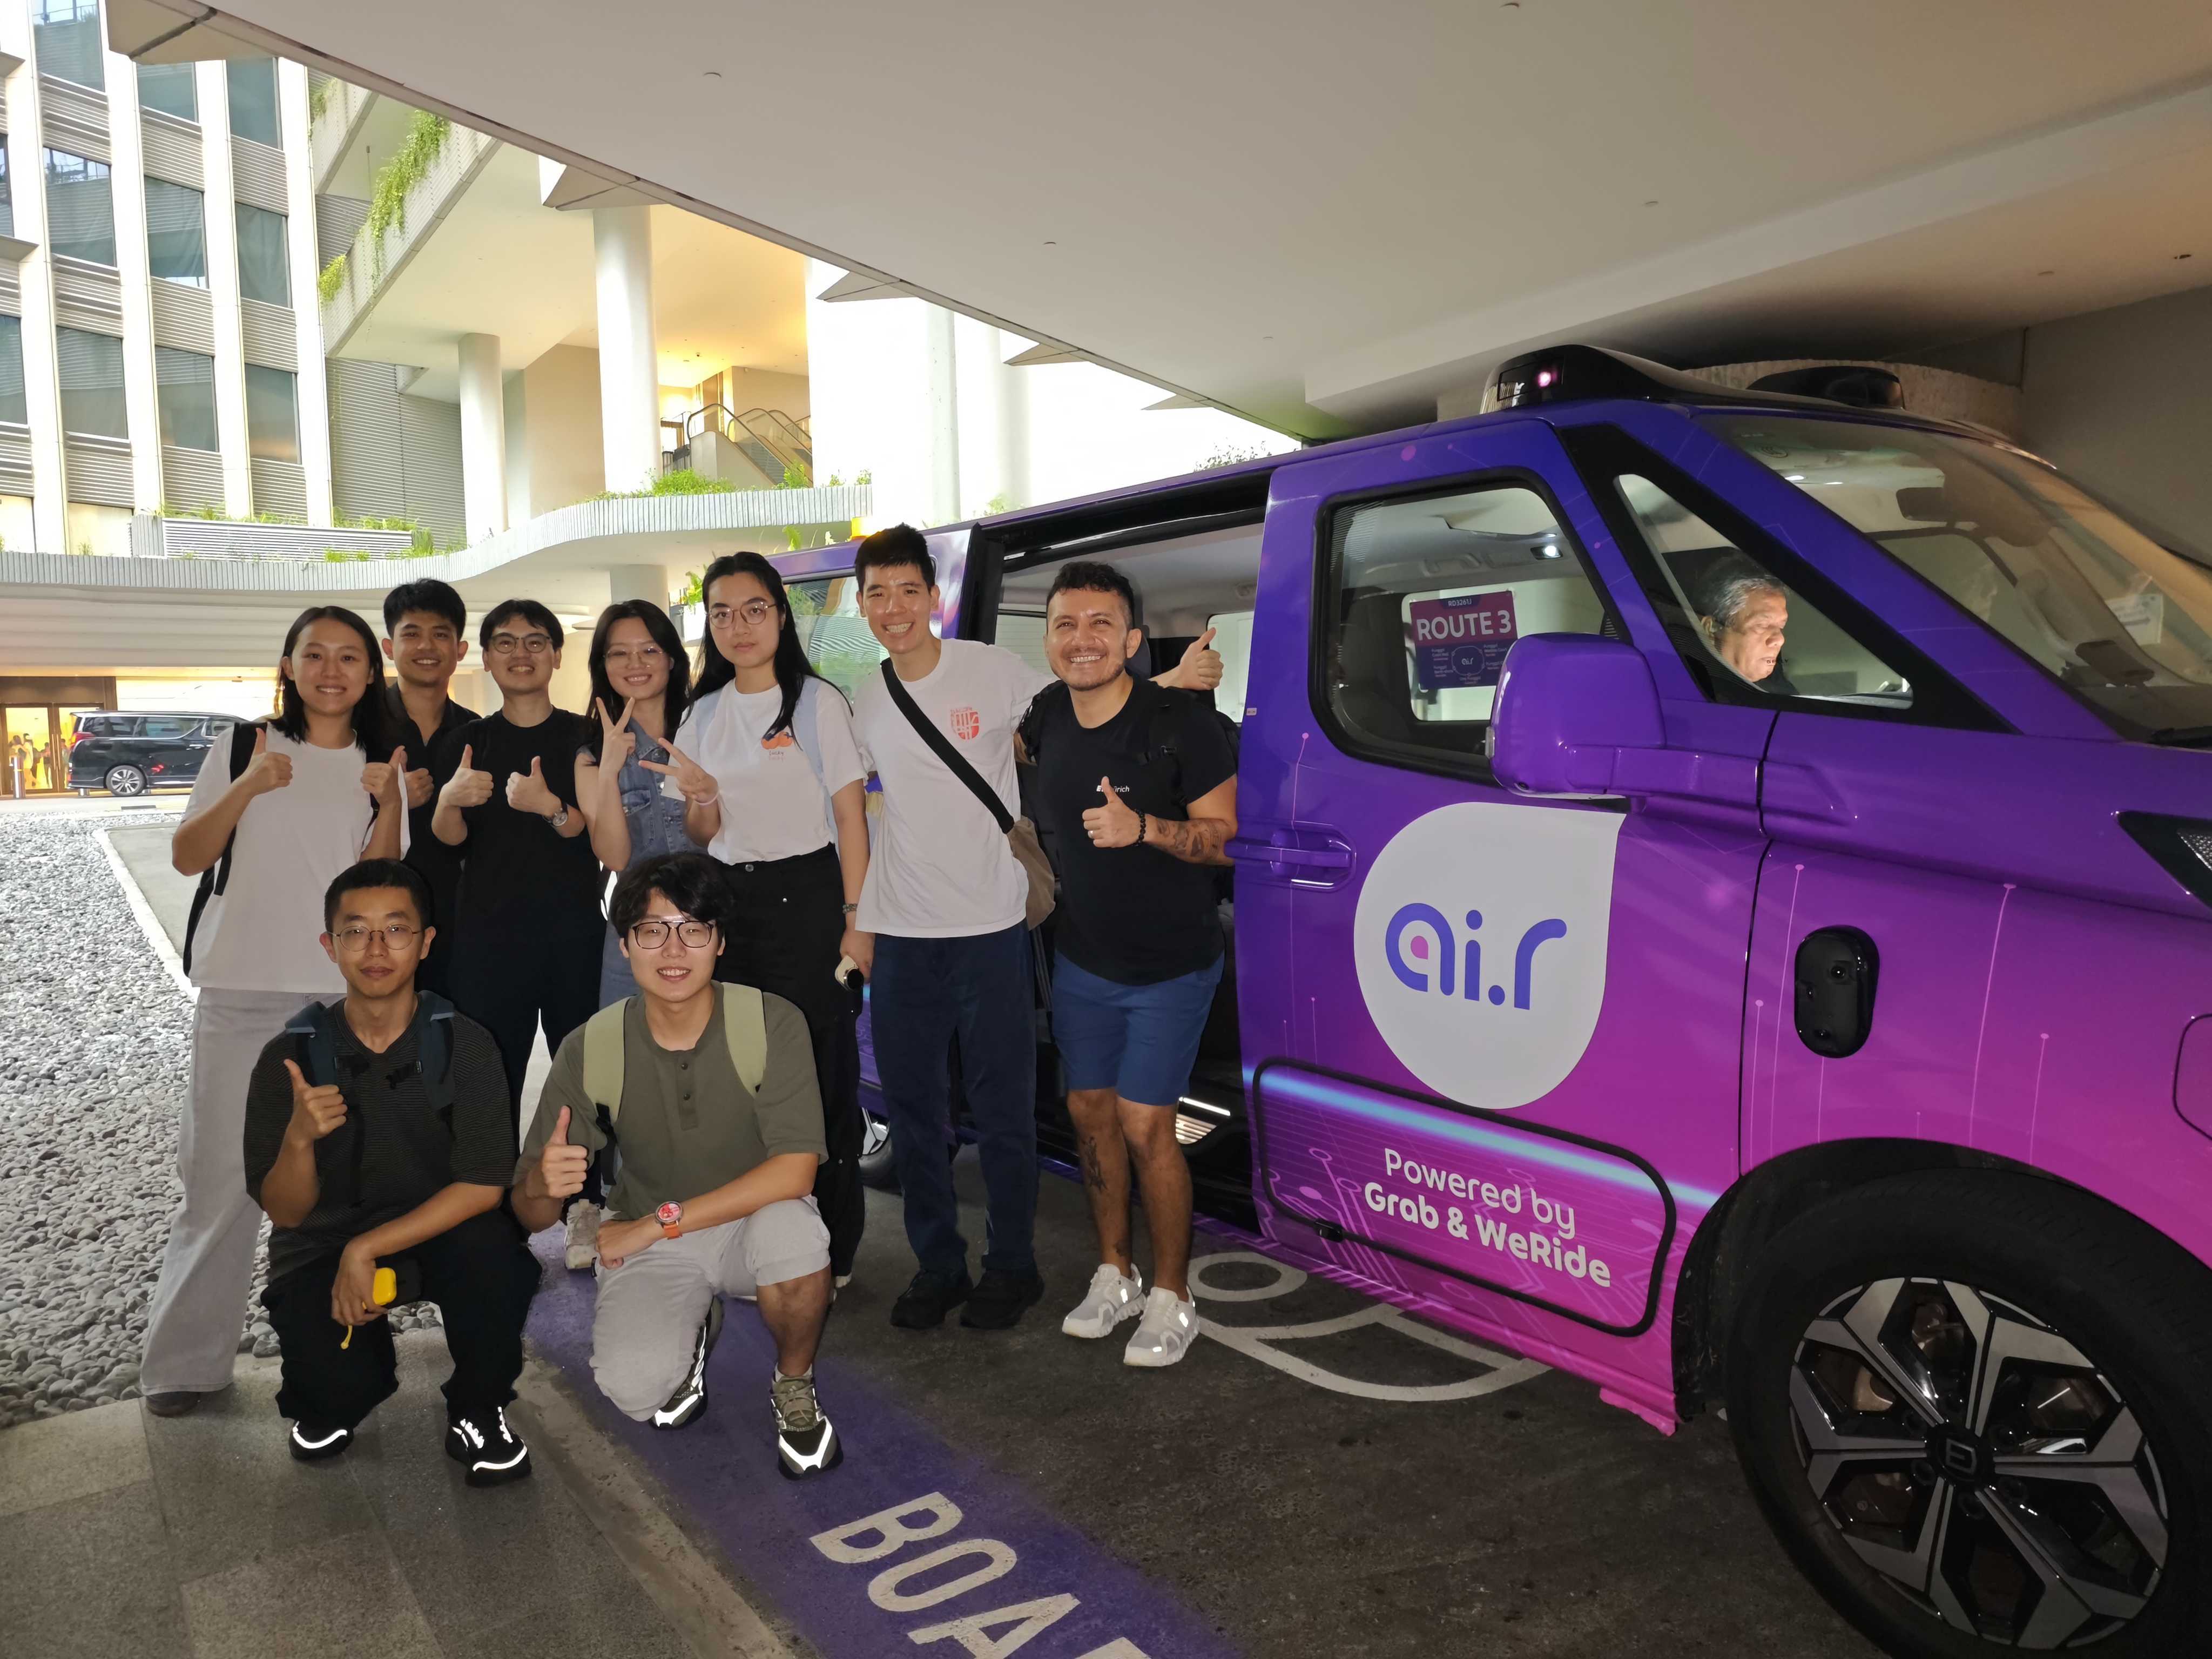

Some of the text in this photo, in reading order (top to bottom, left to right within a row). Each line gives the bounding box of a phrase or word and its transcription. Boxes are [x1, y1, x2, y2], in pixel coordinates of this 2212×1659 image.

[1417, 610, 1512, 640] ROUTE 3
[1365, 1182, 1611, 1287] Grab & WeRide
[1385, 1148, 1575, 1239] Powered by
[809, 1492, 1152, 1659] BOA
